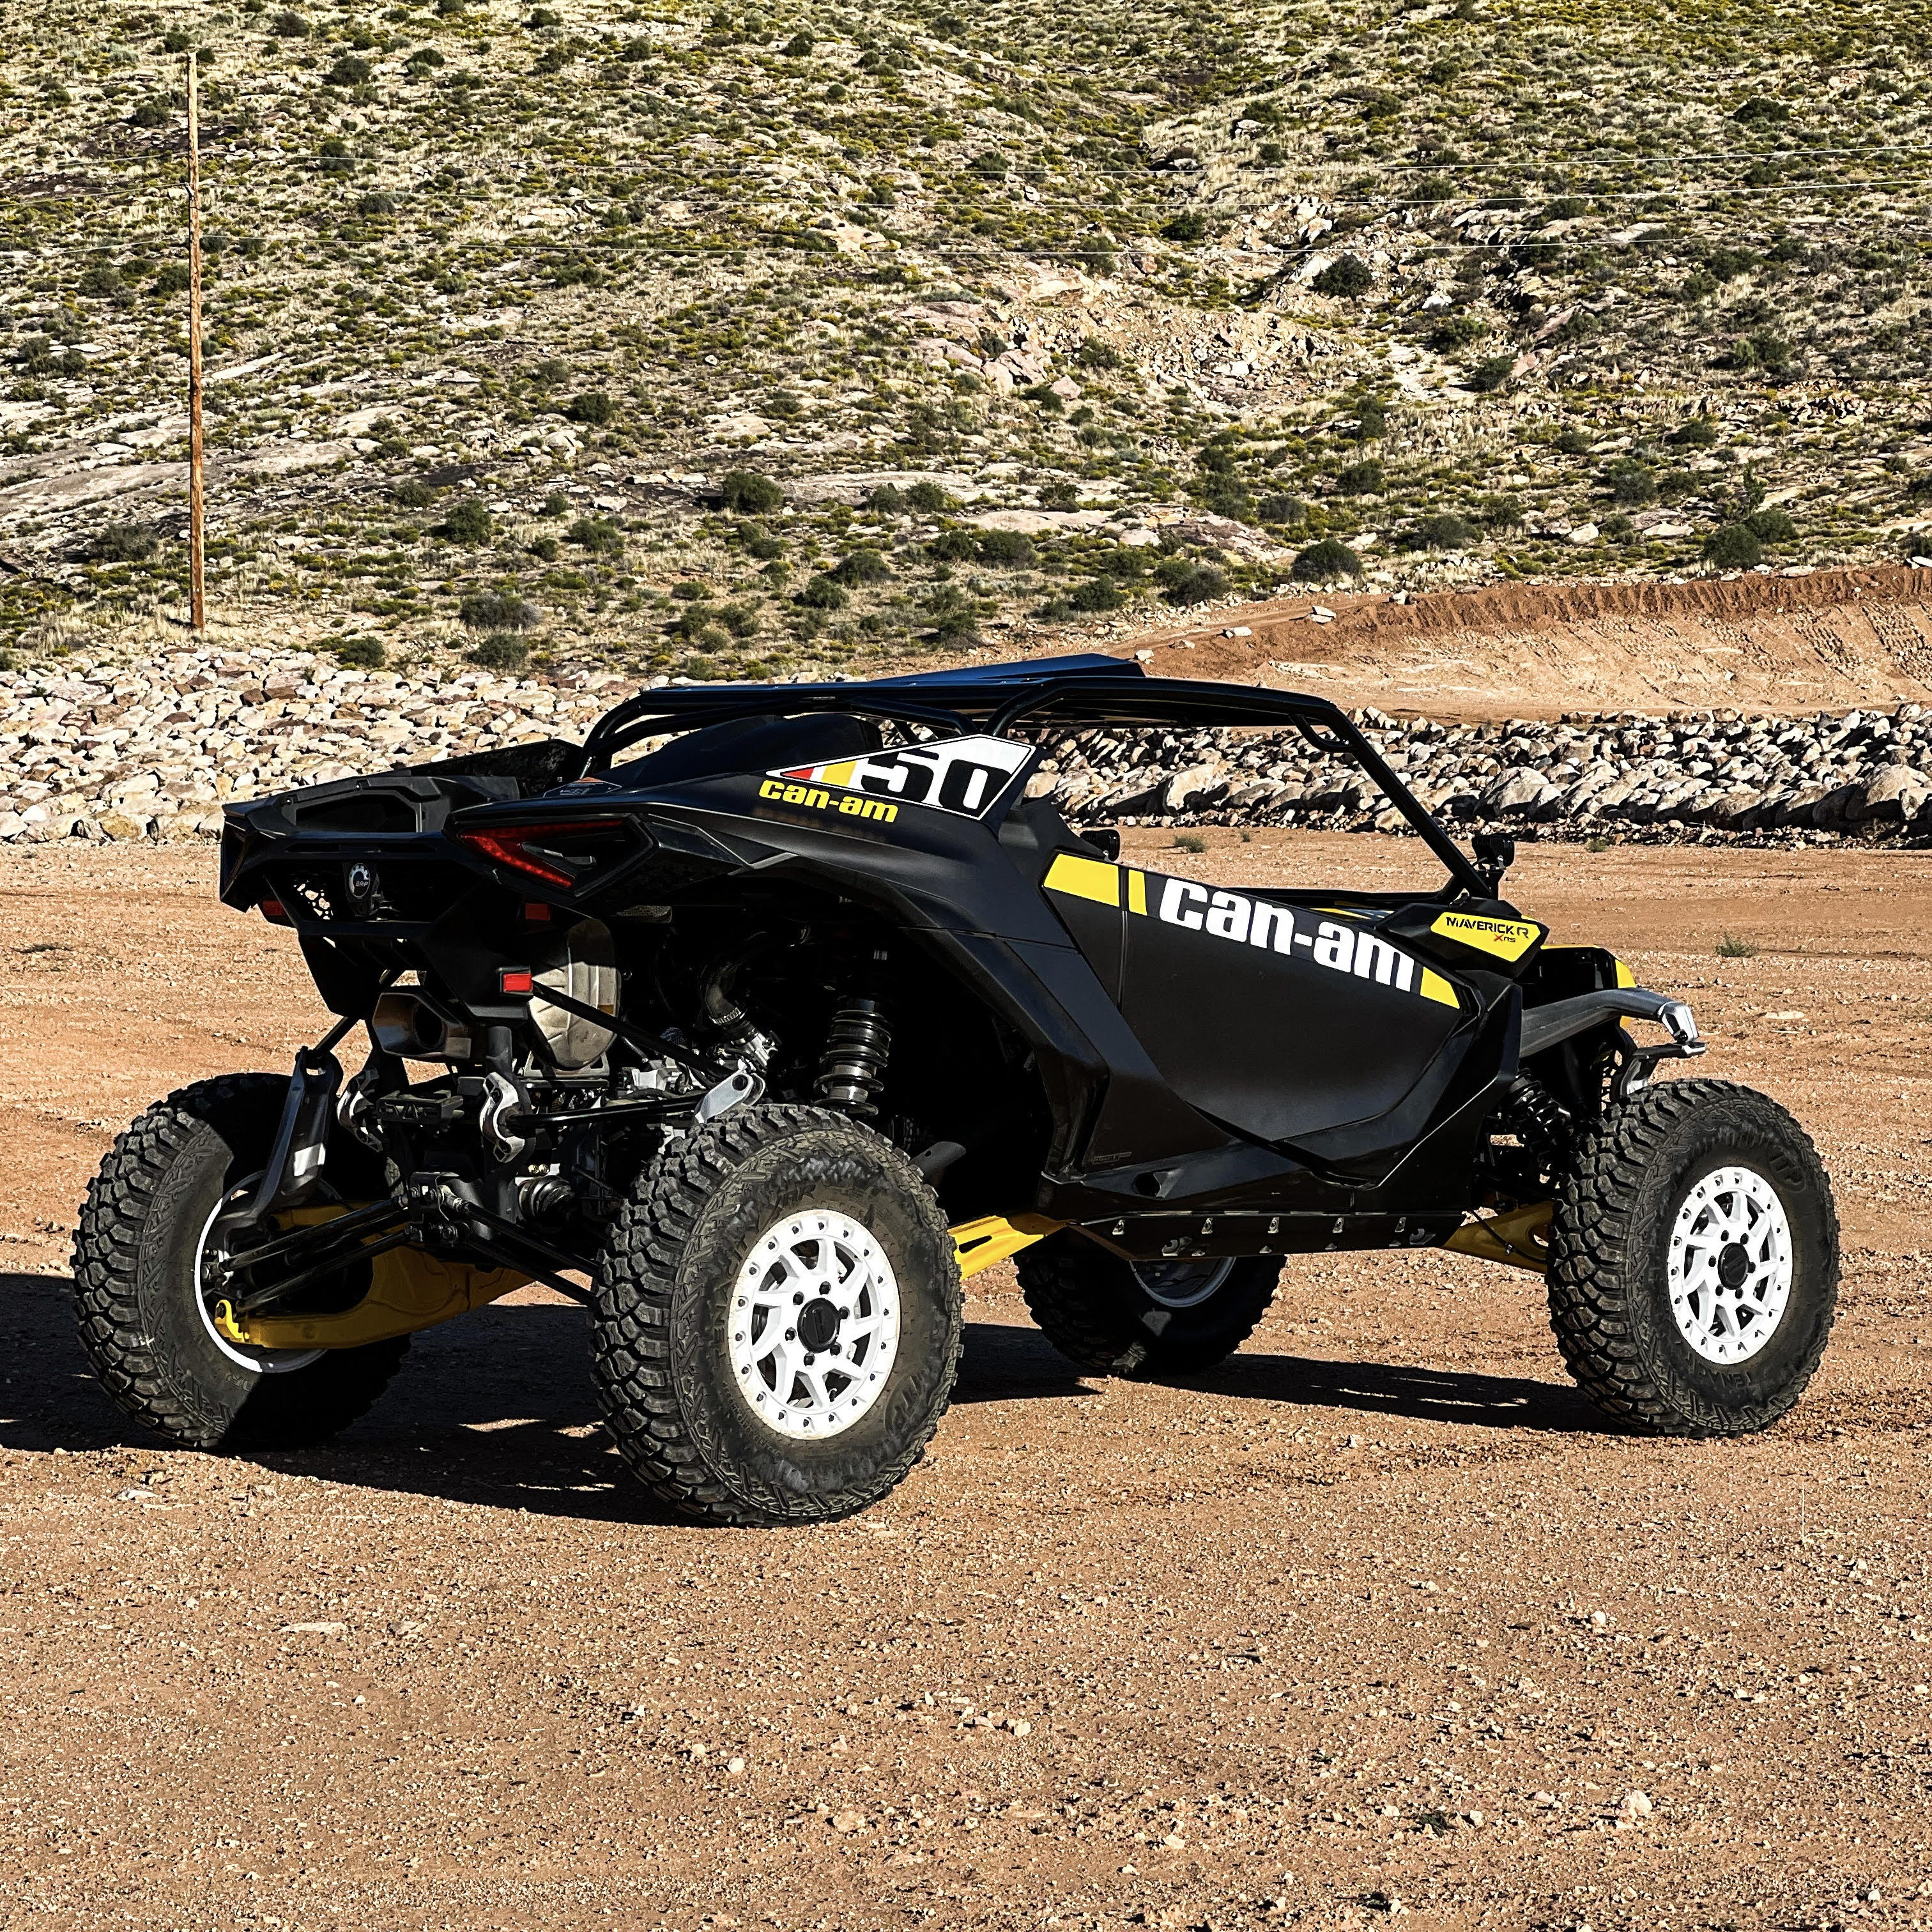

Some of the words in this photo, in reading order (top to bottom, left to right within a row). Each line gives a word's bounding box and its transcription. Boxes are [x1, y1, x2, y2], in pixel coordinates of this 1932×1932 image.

[759, 779, 898, 822] can-am
[861, 746, 1011, 820] 50
[1160, 878, 1414, 992] can-am
[1446, 916, 1514, 935] MAVERICK
[1517, 927, 1529, 939] R
